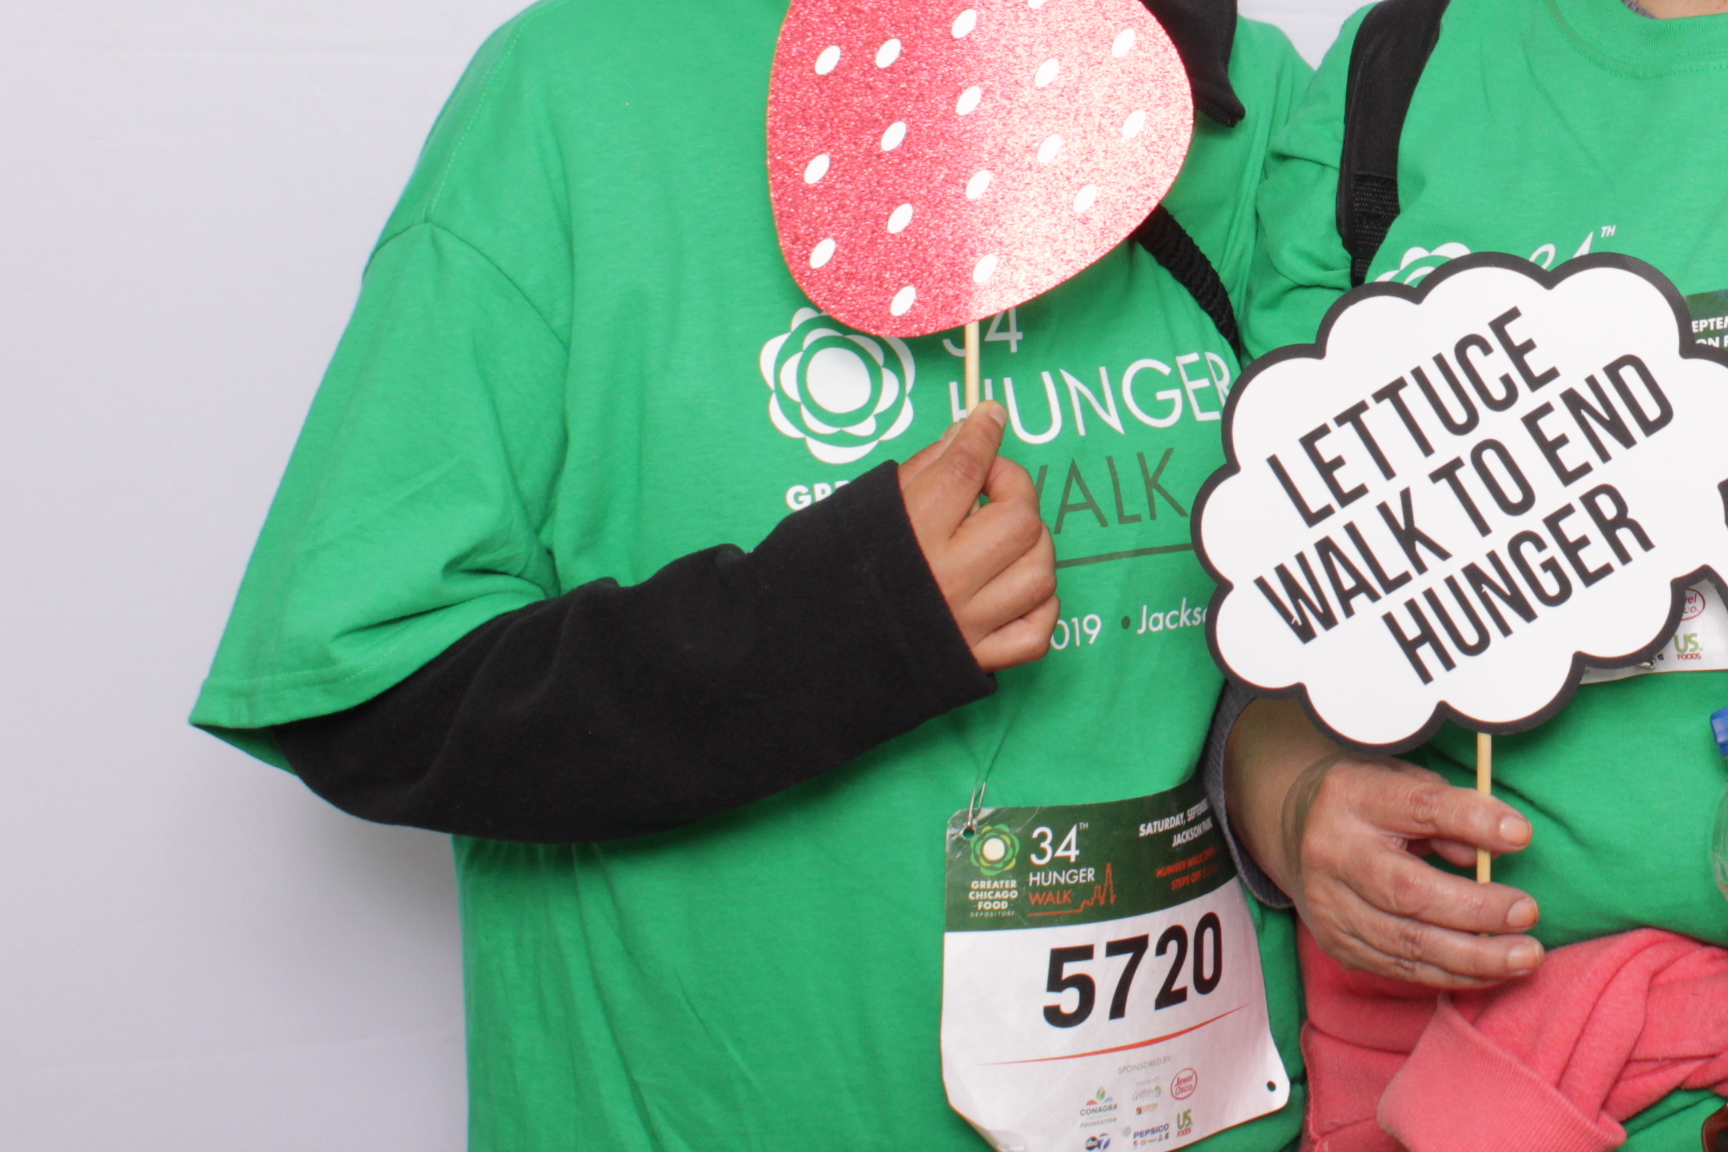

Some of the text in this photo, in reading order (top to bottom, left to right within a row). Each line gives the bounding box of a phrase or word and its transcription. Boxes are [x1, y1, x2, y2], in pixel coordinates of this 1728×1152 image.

[942, 307, 1024, 357] 4
[1266, 306, 1561, 529] LETTUCE
[784, 480, 850, 511] GR
[1036, 448, 1189, 535] ALK
[1254, 353, 1674, 645] WALK TO END
[1381, 483, 1656, 686] HUNGER
[1050, 614, 1102, 650] 019
[1676, 653, 1701, 661] FOODS
[1138, 811, 1186, 838] SATURDAY,
[1171, 821, 1204, 848] JACKSON
[1030, 823, 1080, 866] 34
[971, 879, 1017, 890] GREATER
[1028, 867, 1096, 887] HUNGER
[968, 889, 1019, 901] CHICAGO
[977, 901, 1009, 911] FOOD
[1027, 889, 1073, 906] WALK
[1043, 911, 1223, 1028] 5720
[1118, 1058, 1162, 1074] SPONSORED
[1080, 1103, 1119, 1116] CONAGRA
[1080, 1117, 1118, 1128] FOUNDATION
[1133, 1123, 1170, 1139] PEPSICO
